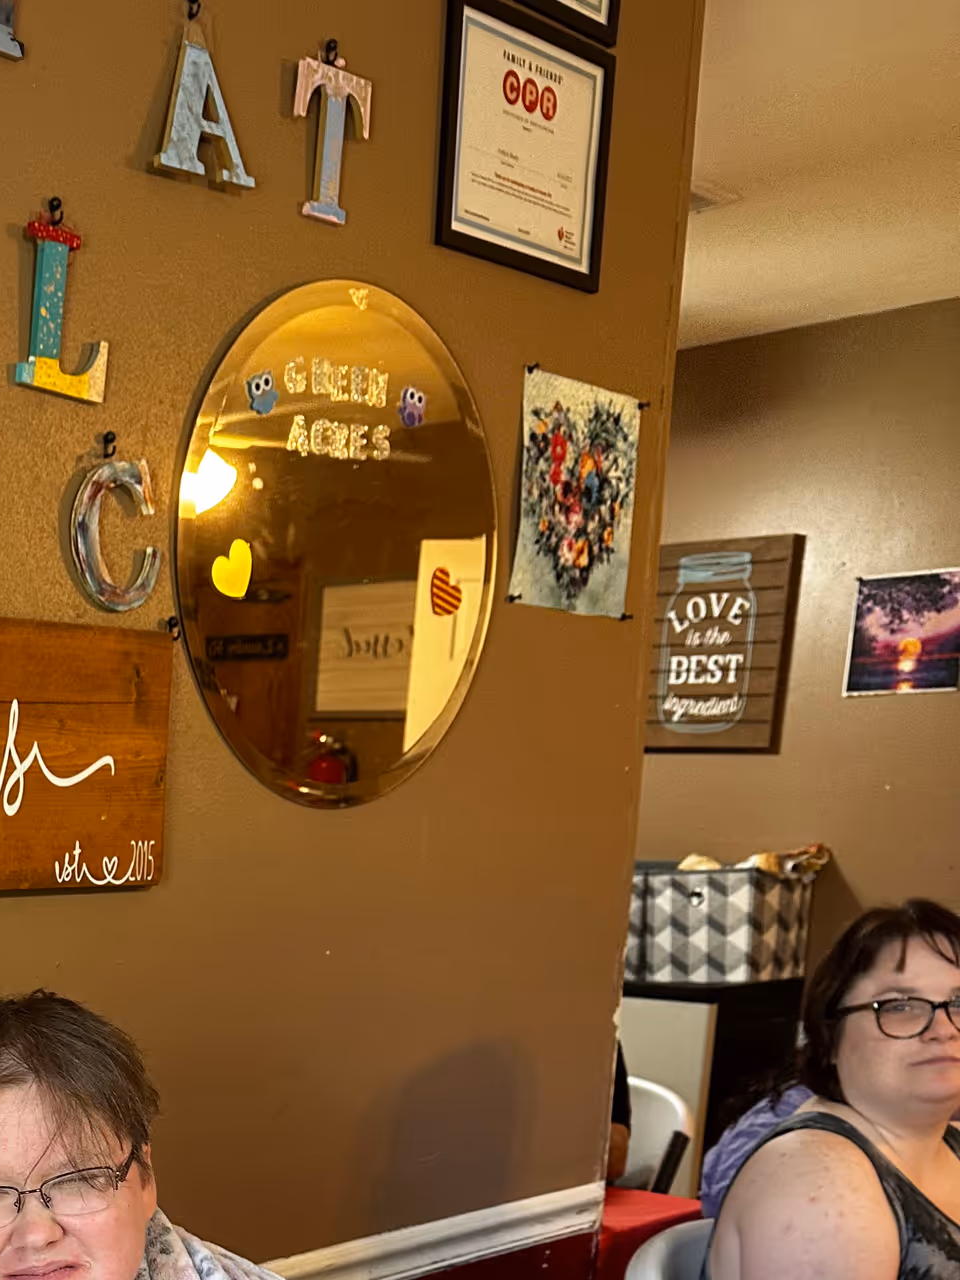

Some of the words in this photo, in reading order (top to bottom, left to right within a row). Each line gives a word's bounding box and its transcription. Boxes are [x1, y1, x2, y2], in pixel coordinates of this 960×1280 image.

[152, 40, 255, 188] A
[504, 72, 556, 119] CPR
[293, 56, 372, 225] T
[15, 220, 109, 403] L
[69, 458, 161, 612] C
[667, 592, 751, 633] LOVE
[685, 628, 701, 646] is
[704, 625, 732, 647] the
[668, 653, 745, 685] BEST
[127, 840, 155, 882] 2015
